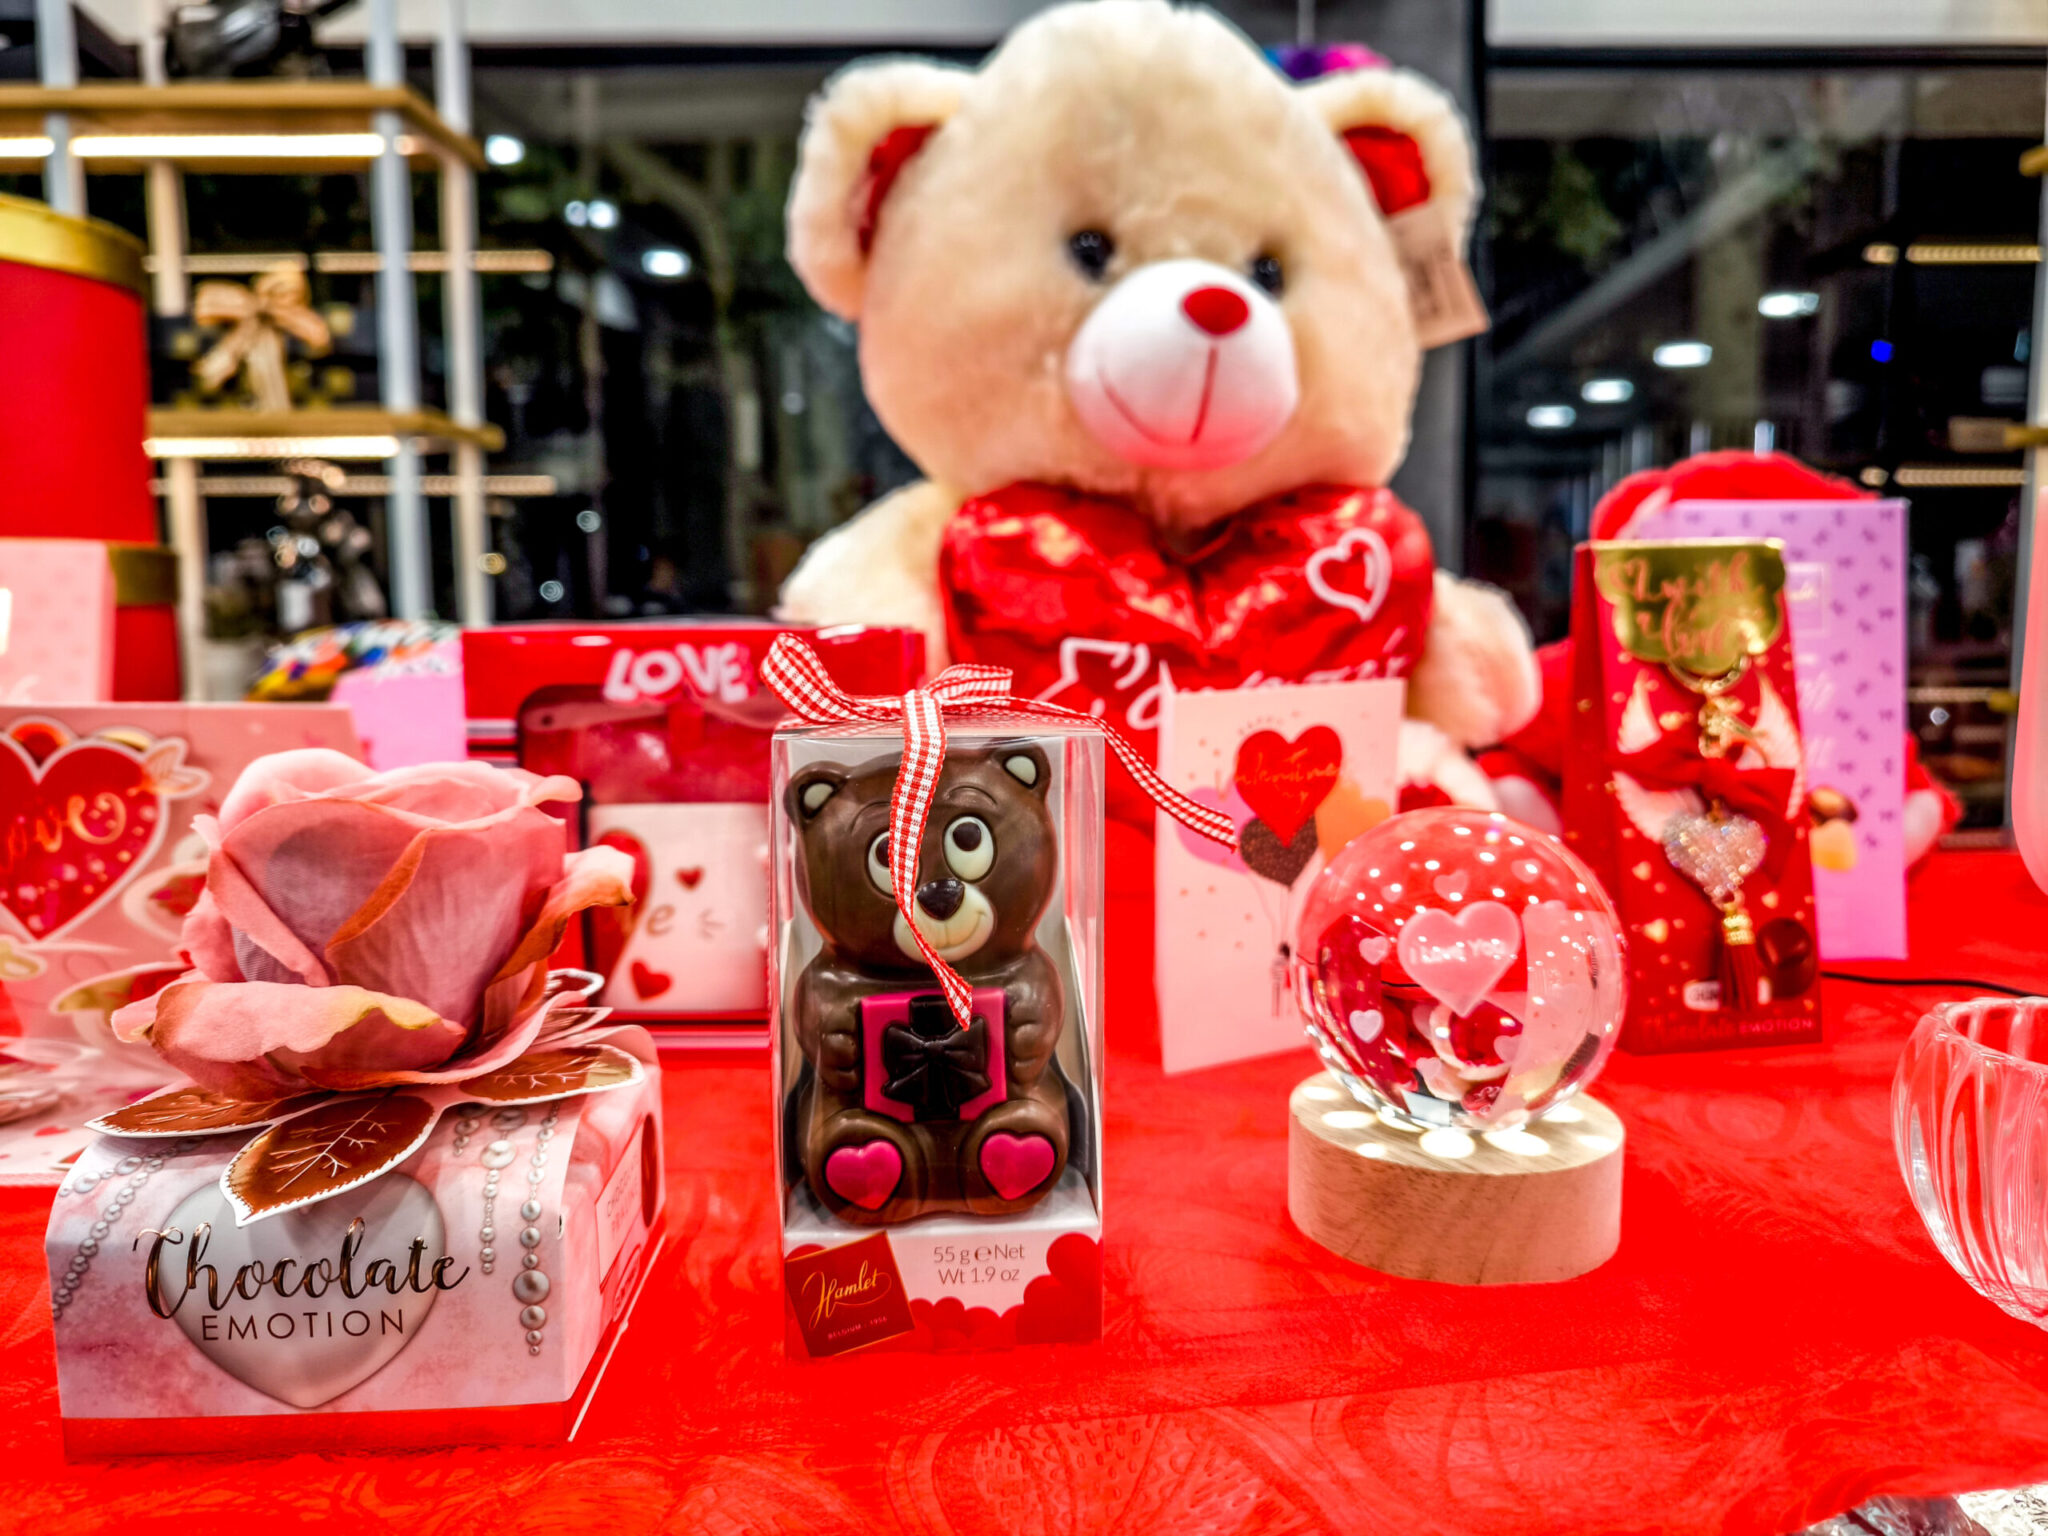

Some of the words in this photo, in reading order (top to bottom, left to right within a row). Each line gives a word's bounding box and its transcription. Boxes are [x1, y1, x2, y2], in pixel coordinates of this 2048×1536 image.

[604, 643, 751, 702] LOVE
[1737, 1017, 1816, 1036] EMOTION
[133, 1217, 470, 1320] Chocolate
[933, 1246, 955, 1263] 55
[959, 1249, 971, 1265] g
[938, 1268, 965, 1285] Wt
[971, 1266, 996, 1283] 1.9
[1000, 1269, 1020, 1282] oz
[801, 1260, 892, 1329] Hamlet
[202, 1309, 404, 1341] EMOTION
